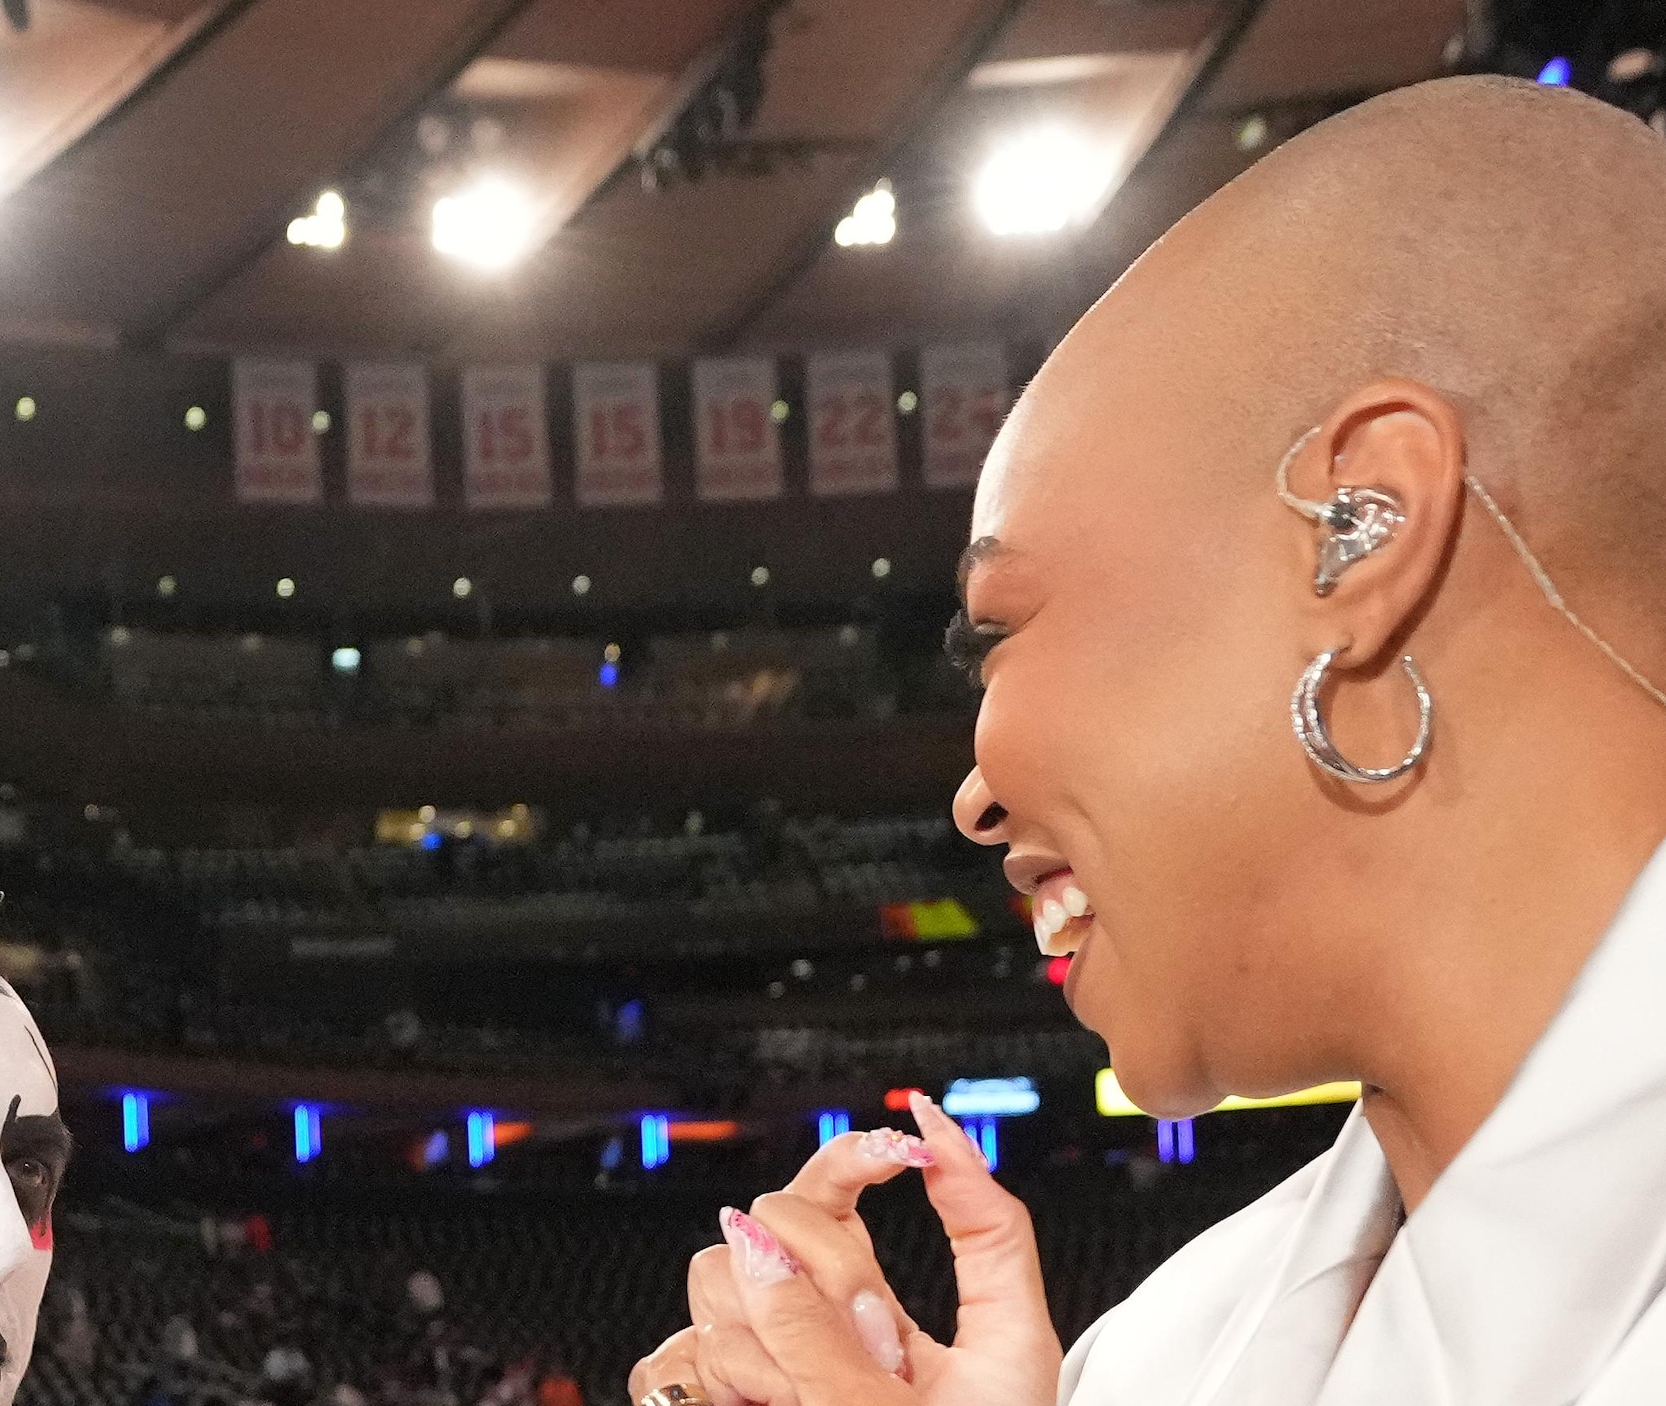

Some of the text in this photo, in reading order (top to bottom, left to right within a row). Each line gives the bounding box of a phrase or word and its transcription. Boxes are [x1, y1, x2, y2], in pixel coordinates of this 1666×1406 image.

[247, 400, 305, 456] 10
[359, 405, 415, 460] 12
[479, 407, 534, 462] 15
[590, 403, 646, 460] 15
[709, 399, 767, 455] 19
[819, 391, 884, 447] 22
